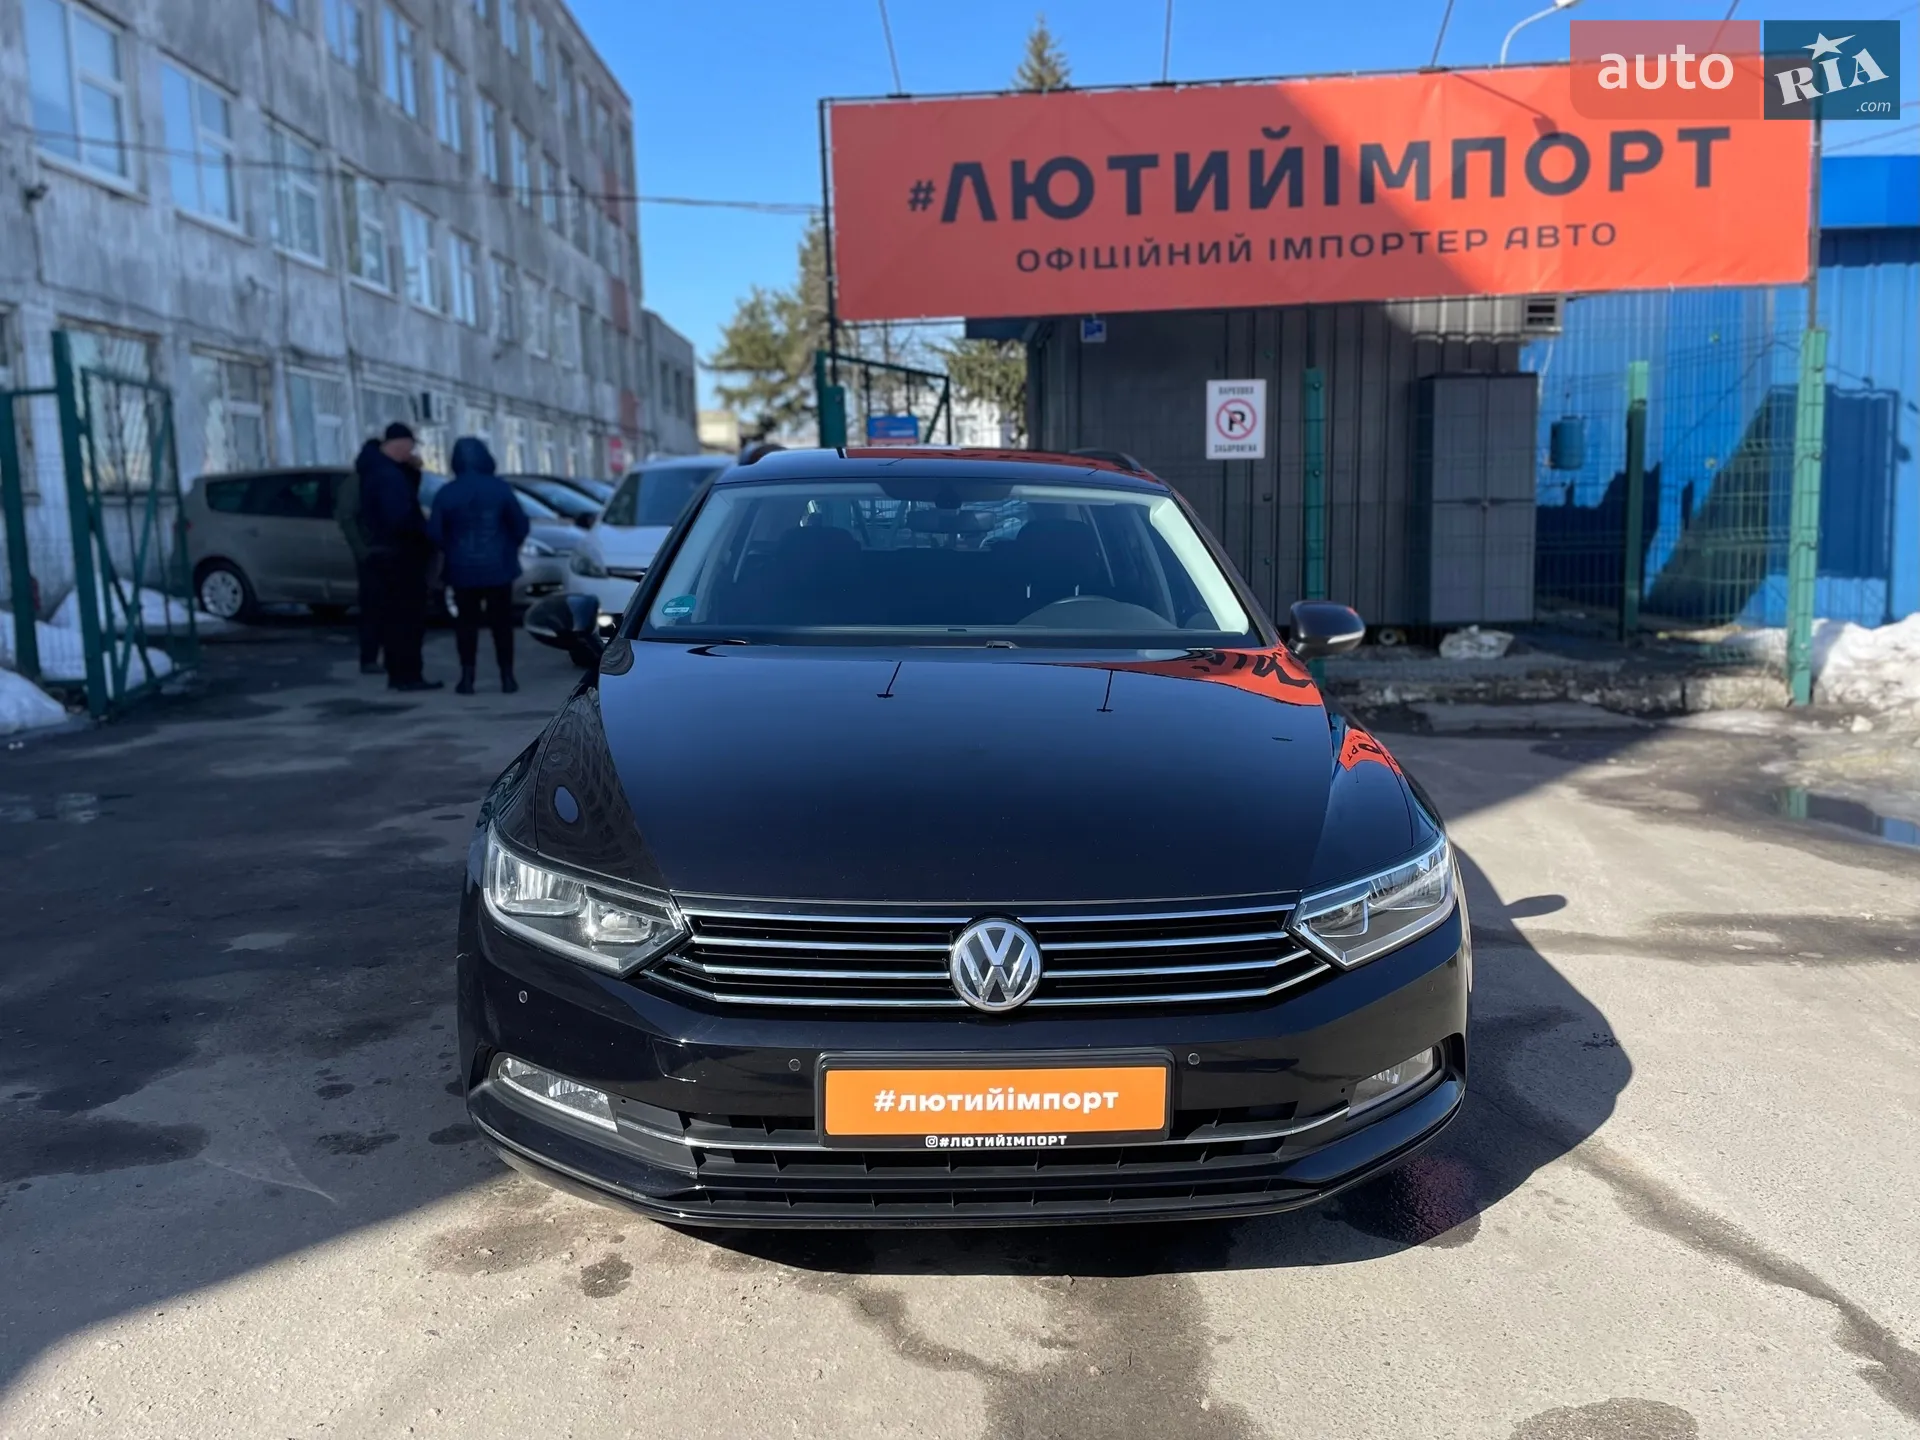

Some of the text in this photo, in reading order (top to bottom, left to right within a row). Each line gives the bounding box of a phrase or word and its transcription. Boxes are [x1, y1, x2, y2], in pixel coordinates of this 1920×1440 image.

[908, 126, 1731, 223] #ЛЮТИЙІМПОРТ
[1269, 229, 1488, 262] ІМПОРТЕР
[1505, 222, 1617, 250] АВТО
[873, 1086, 1119, 1114] #лютийімпорт
